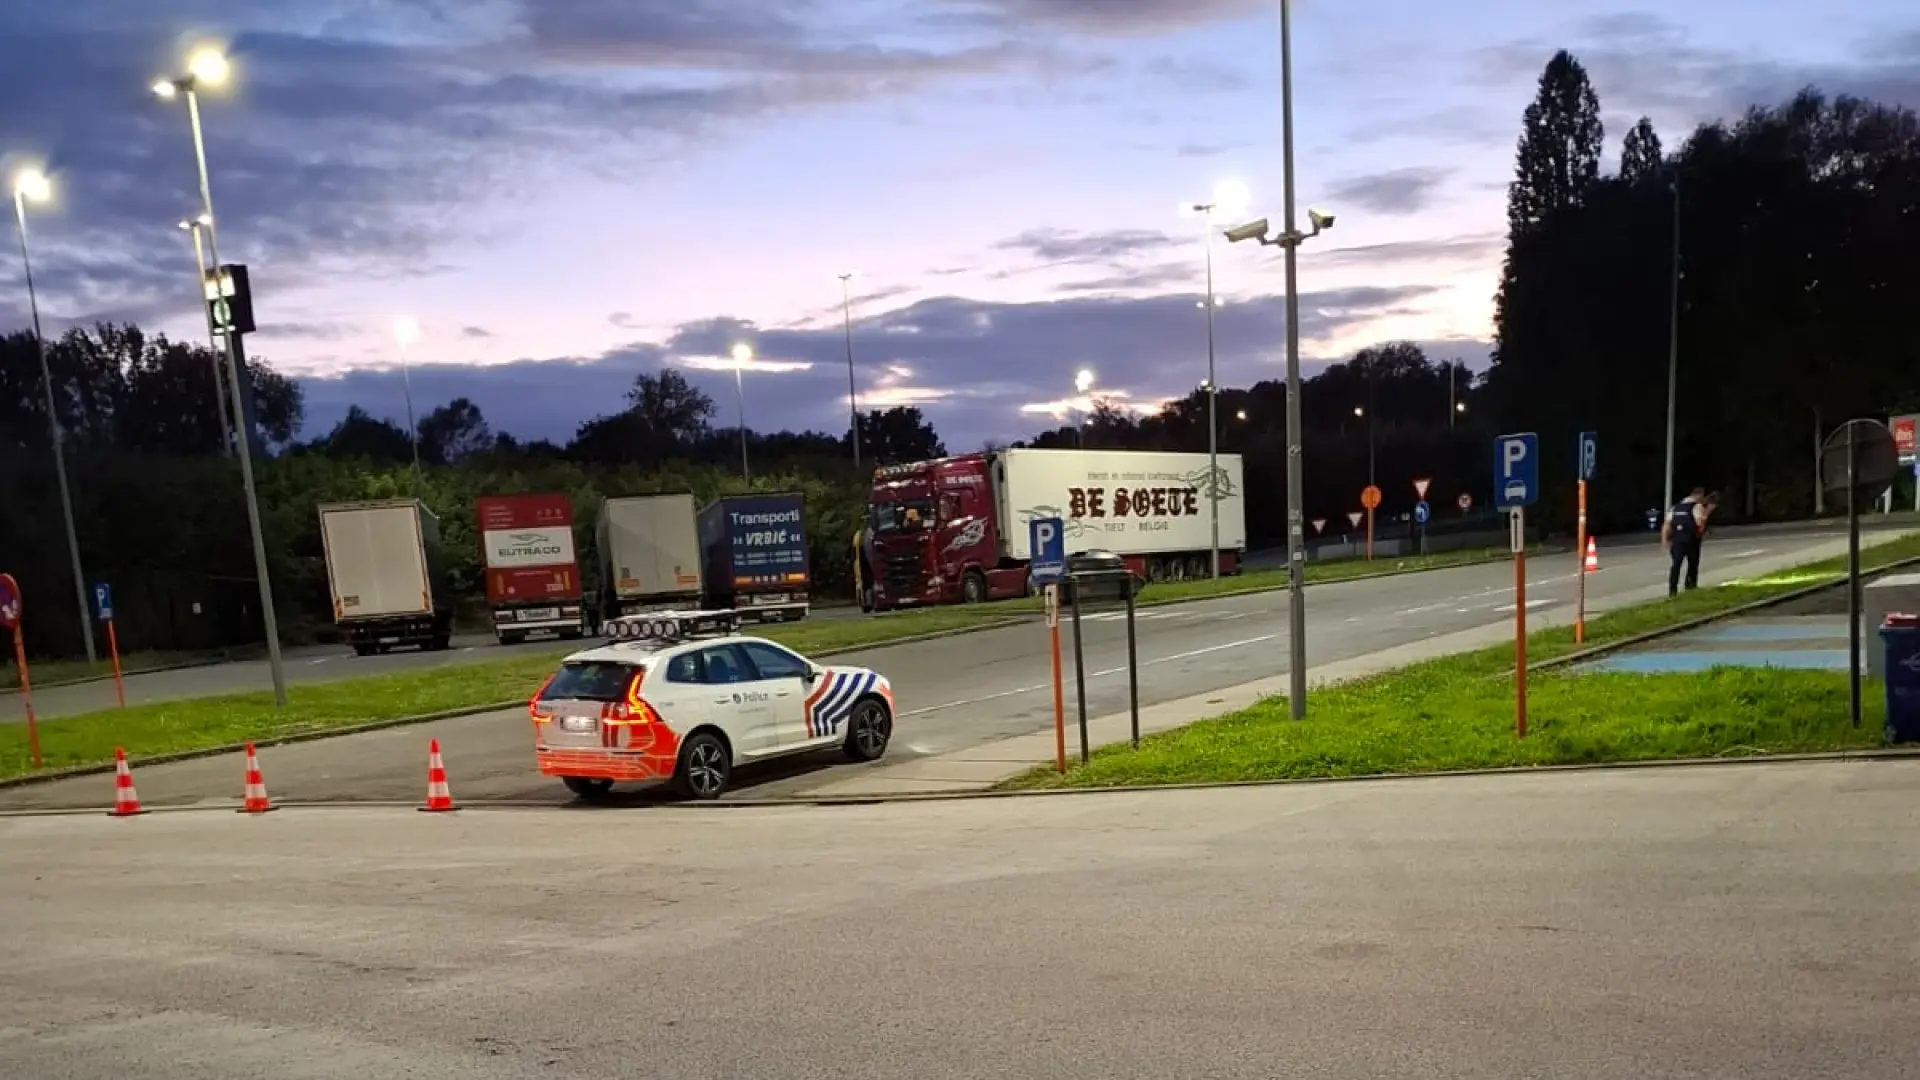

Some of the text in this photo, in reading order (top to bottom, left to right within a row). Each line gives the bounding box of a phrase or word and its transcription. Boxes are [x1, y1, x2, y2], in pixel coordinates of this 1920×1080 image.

[1503, 440, 1526, 477] P
[730, 508, 800, 527] Transporti
[1068, 487, 1198, 518] DE SOETE
[498, 545, 561, 557] EUTRACO
[1036, 523, 1054, 556] P
